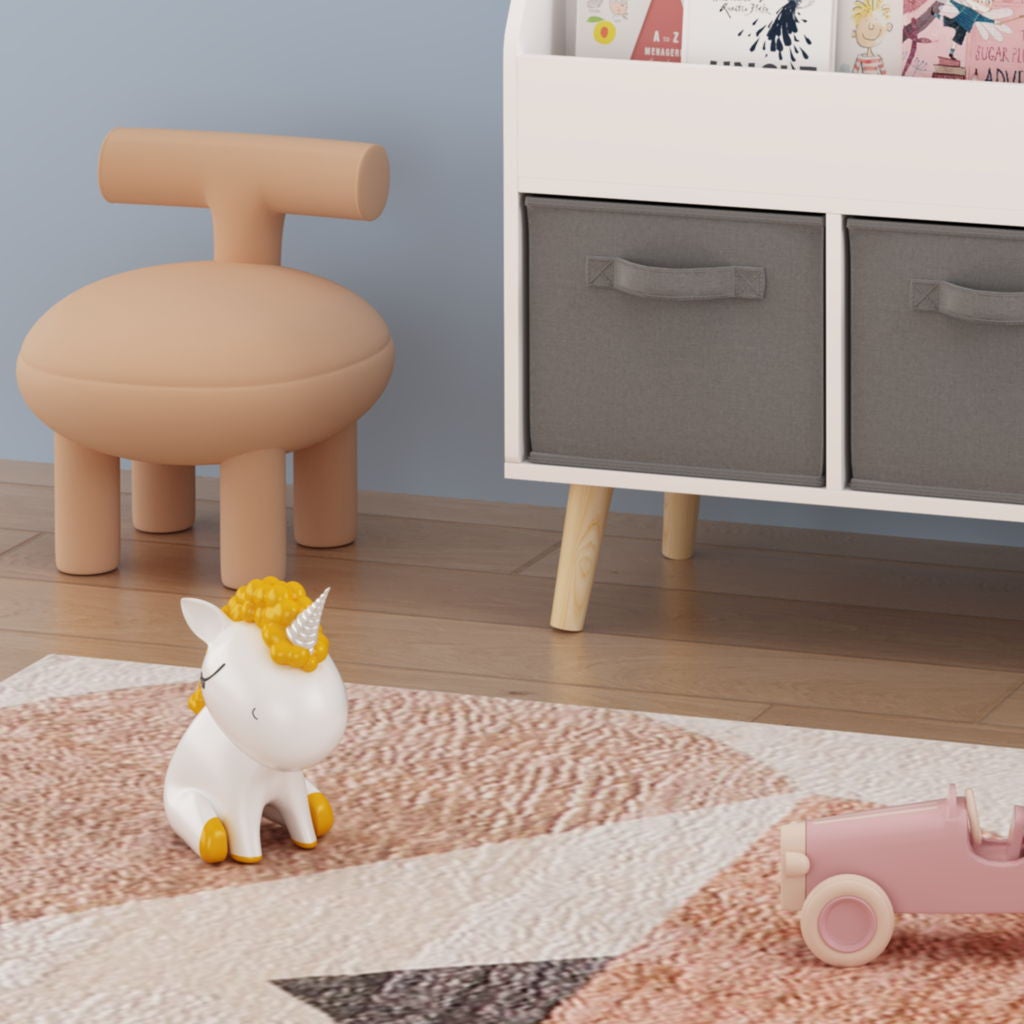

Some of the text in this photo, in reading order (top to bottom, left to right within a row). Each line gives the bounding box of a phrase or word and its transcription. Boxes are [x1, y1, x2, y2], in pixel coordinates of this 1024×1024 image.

[653, 30, 660, 42] A
[672, 31, 680, 44] Z
[644, 47, 681, 57] MENAGER
[975, 46, 1009, 63] SUGAR
